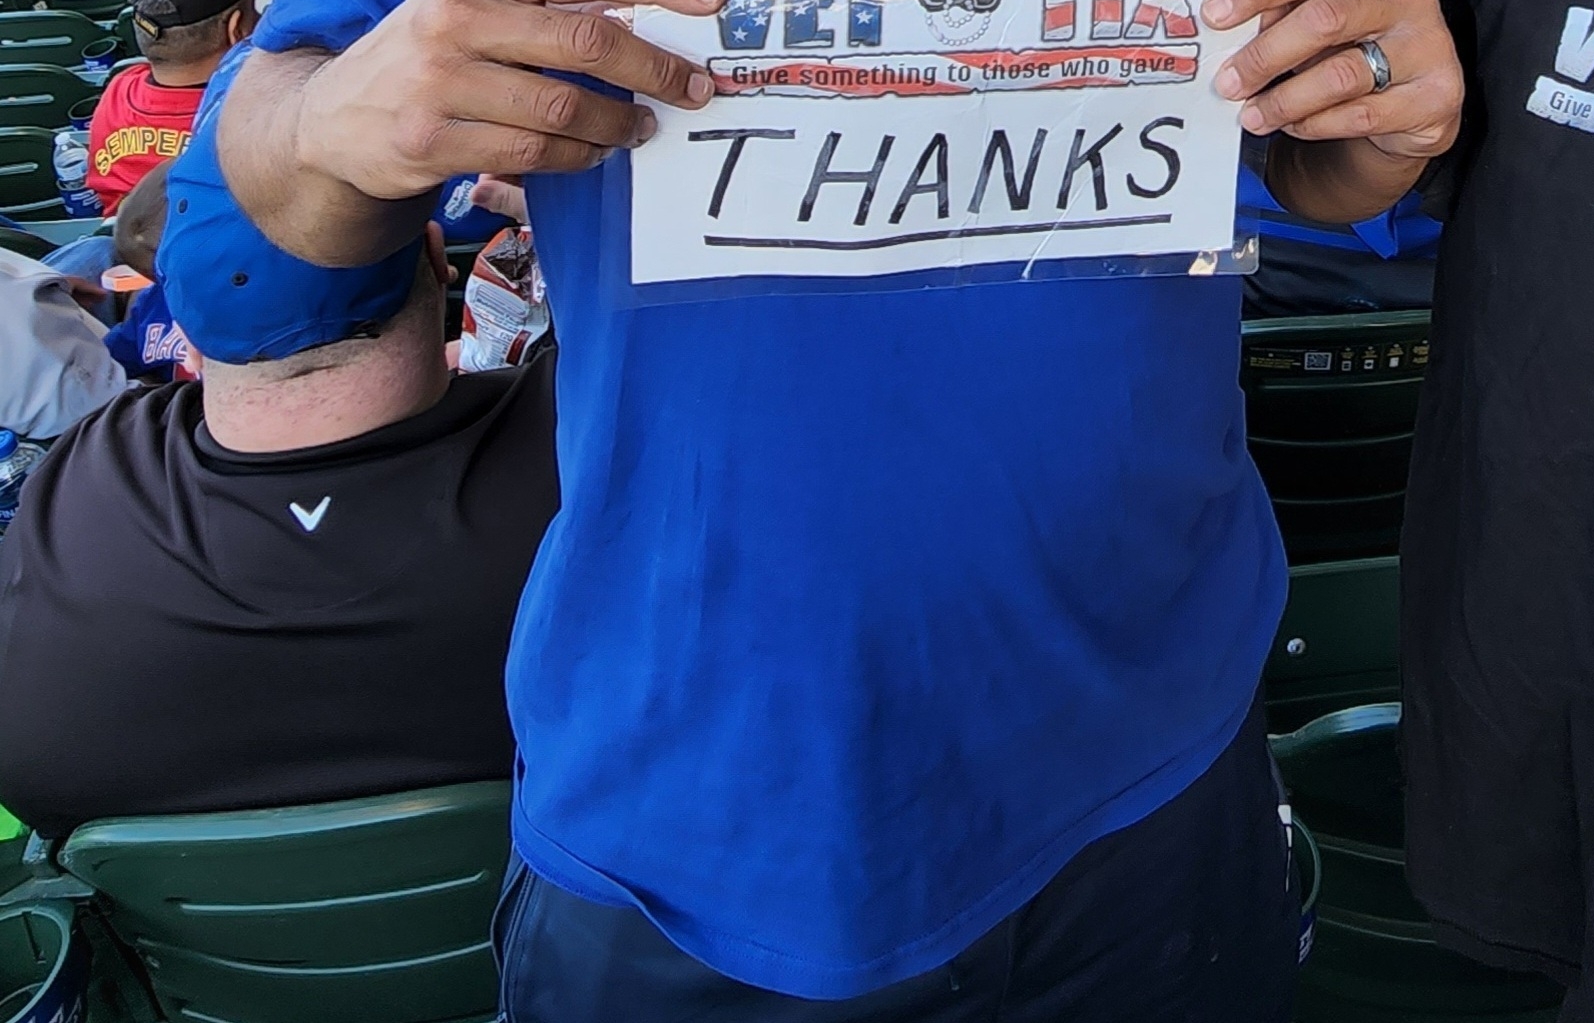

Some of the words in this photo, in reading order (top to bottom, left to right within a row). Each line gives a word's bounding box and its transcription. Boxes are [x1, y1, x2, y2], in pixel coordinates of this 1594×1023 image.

[731, 65, 789, 85] Give
[798, 63, 938, 87] something
[947, 63, 971, 82] to
[981, 59, 1051, 81] those
[1060, 56, 1110, 77] who
[1119, 56, 1176, 77] gave
[1549, 90, 1593, 119] Give
[687, 115, 1186, 226] THANKS
